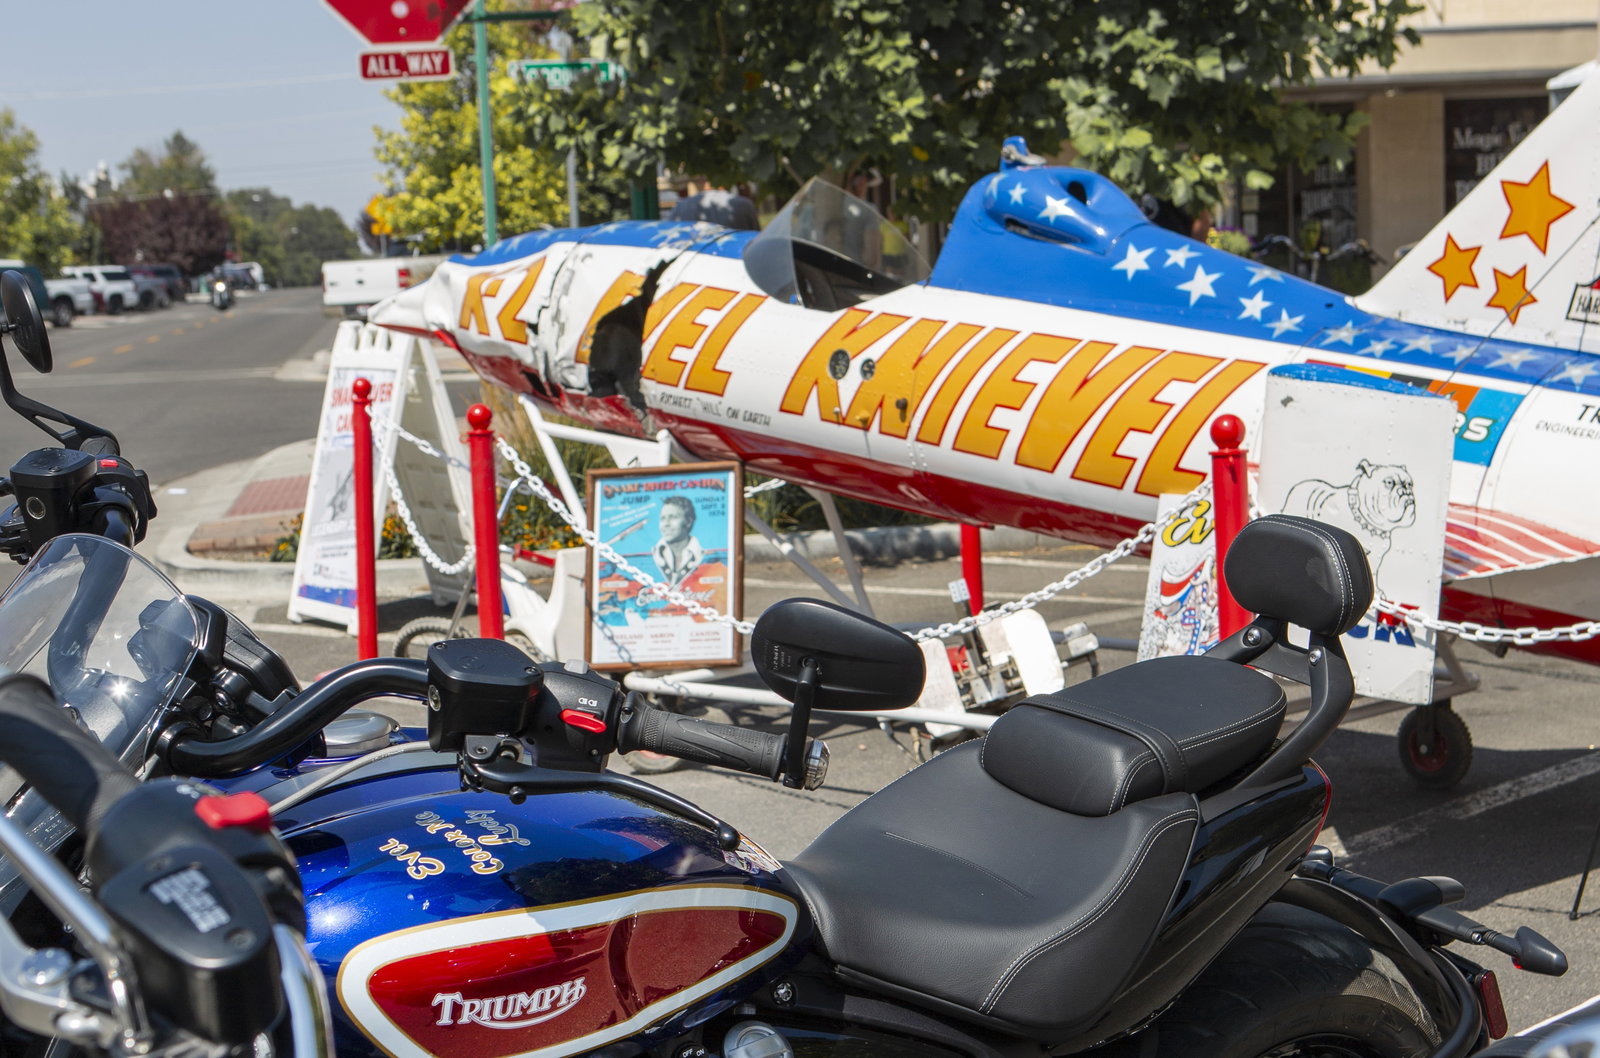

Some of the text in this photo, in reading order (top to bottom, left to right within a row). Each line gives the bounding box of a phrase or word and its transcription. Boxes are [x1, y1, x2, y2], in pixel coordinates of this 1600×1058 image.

[367, 51, 445, 77] ALL WAY
[779, 307, 1267, 498] KNIEVEL
[726, 407, 740, 419] ON
[742, 410, 772, 427] EARTH
[620, 495, 651, 505] JUMP
[431, 976, 587, 1029] TRIUMPH
[696, 1048, 705, 1057] ON
